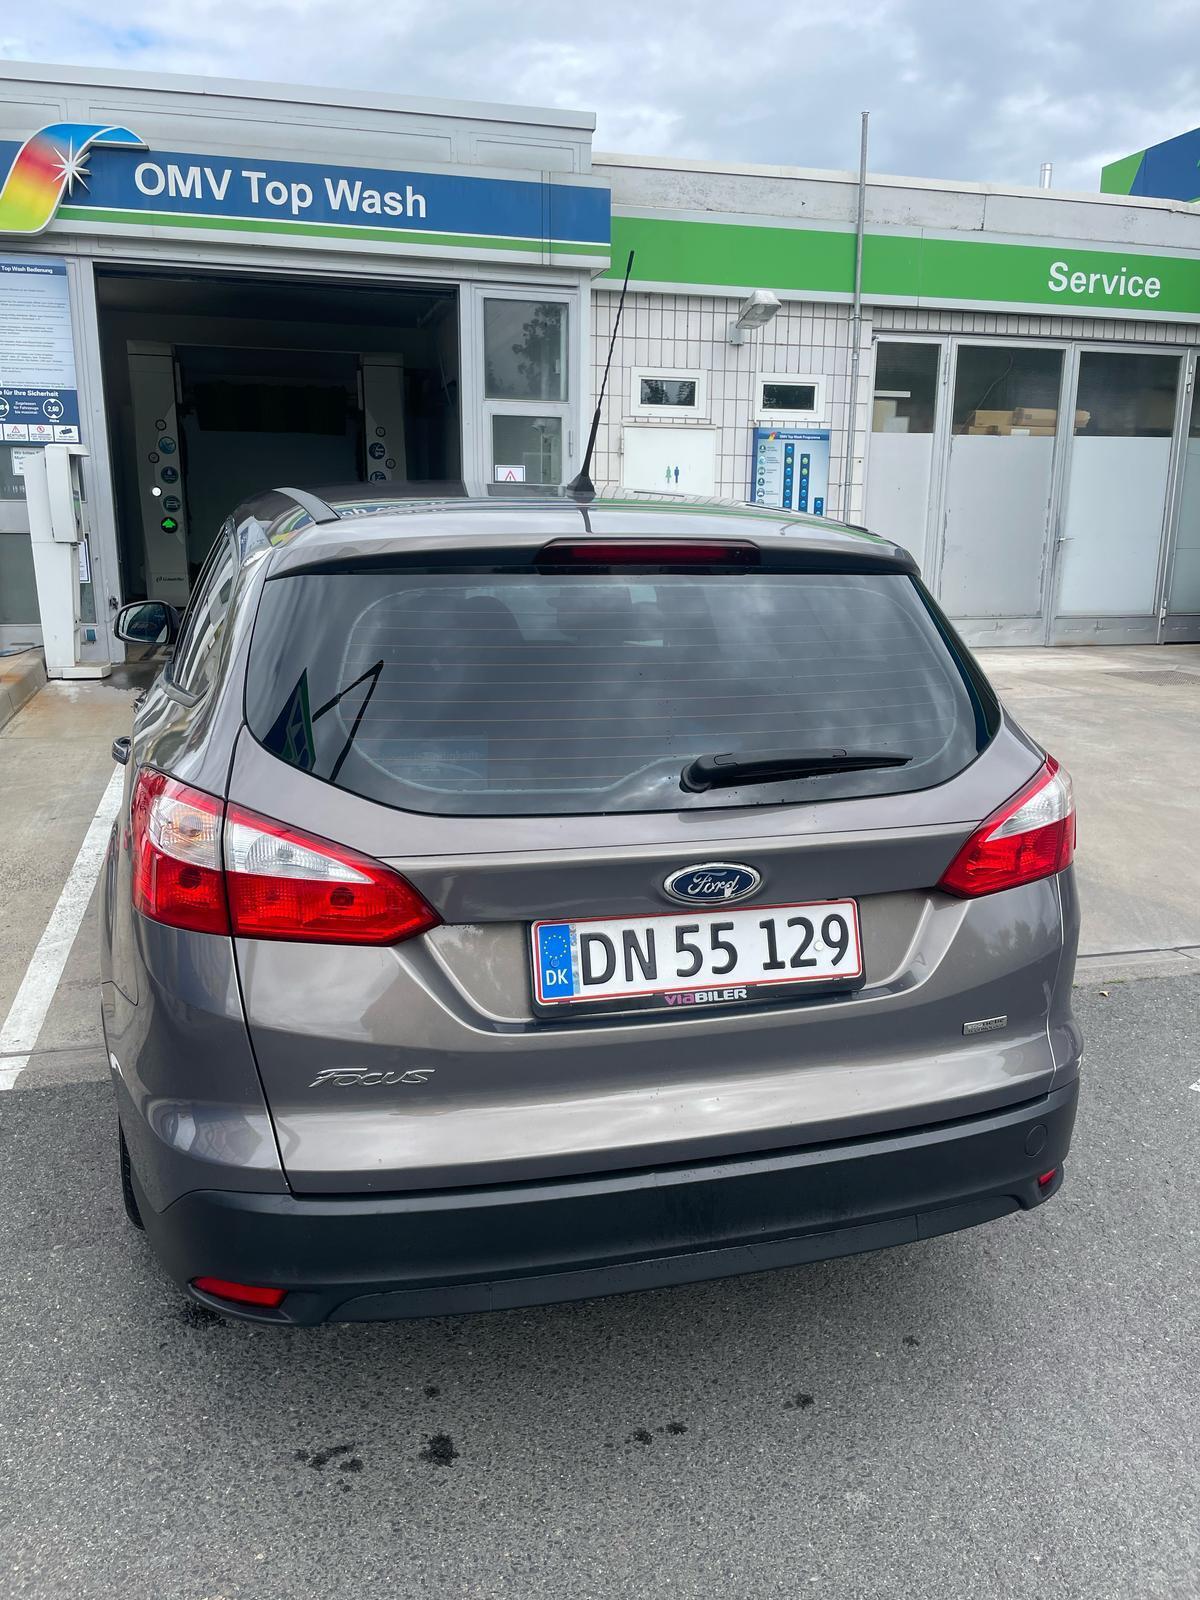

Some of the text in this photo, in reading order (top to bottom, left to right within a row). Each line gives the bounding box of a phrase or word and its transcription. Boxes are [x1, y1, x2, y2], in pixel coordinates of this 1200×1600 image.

[134, 162, 426, 218] OMV Top Wash
[26, 266, 53, 274] Bedienung
[1047, 261, 1161, 298] Service
[687, 871, 740, 895] Ford
[580, 913, 850, 986] DN 55 129
[546, 969, 569, 986] DK
